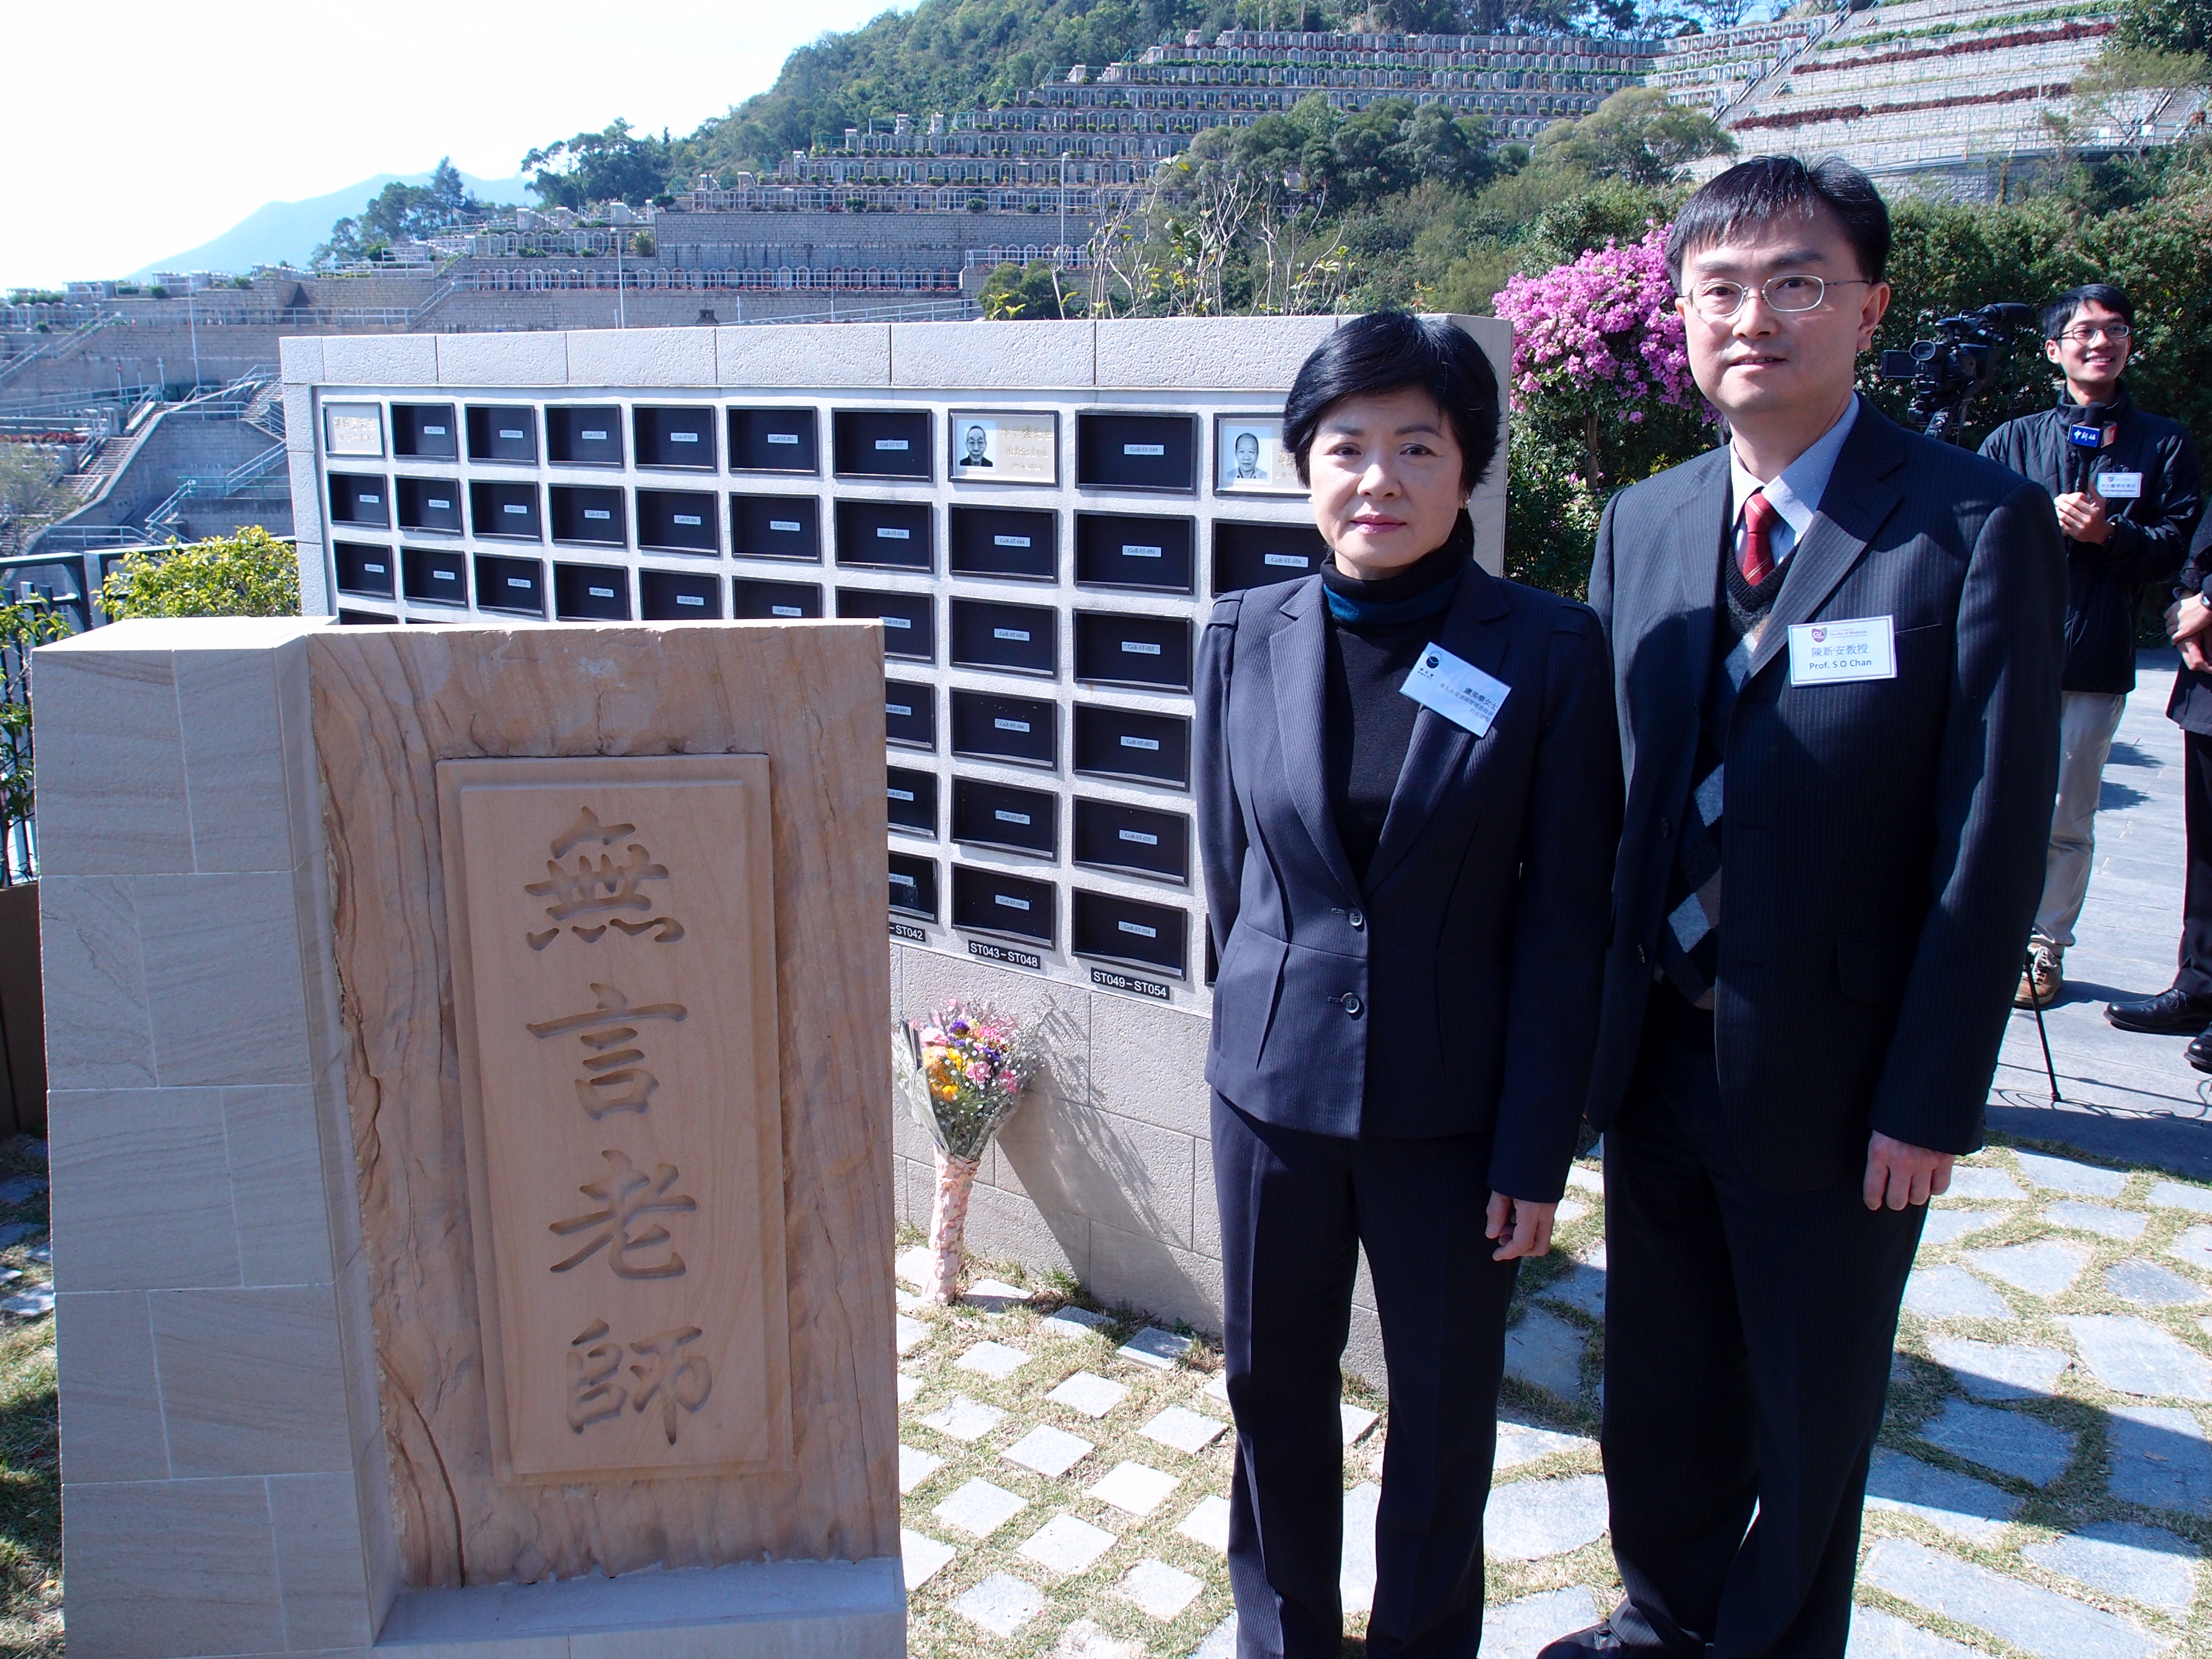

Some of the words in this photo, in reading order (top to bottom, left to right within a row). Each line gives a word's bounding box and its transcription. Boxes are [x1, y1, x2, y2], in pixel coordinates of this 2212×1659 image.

[1811, 643, 1868, 657] 陳新安教授
[1126, 739, 1153, 747] GoR-ST-052
[1125, 833, 1152, 842] GoR-ST-053
[1124, 924, 1151, 934] GoR-ST-054
[970, 942, 1038, 968] ST043-ST048
[1093, 971, 1167, 997] ST049-ST054
[526, 805, 712, 1446] 無言老師
